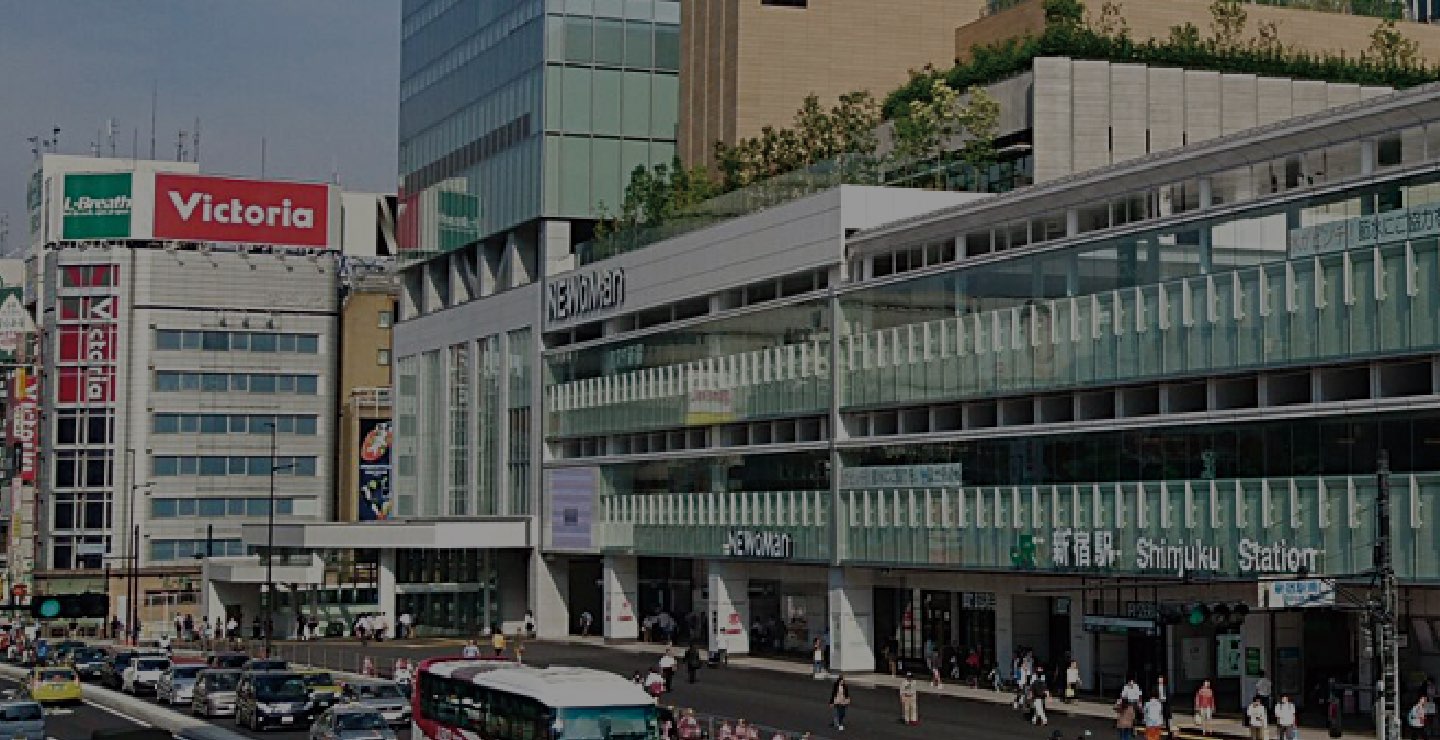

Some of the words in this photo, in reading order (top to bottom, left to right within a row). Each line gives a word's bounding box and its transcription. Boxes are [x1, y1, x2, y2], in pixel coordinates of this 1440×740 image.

[168, 191, 313, 229] Victoria
[88, 297, 114, 400] Vctoria
[1053, 528, 1115, 567] 新宿駅
[1136, 536, 1220, 578] Shinjuku
[1238, 537, 1318, 571] Station
